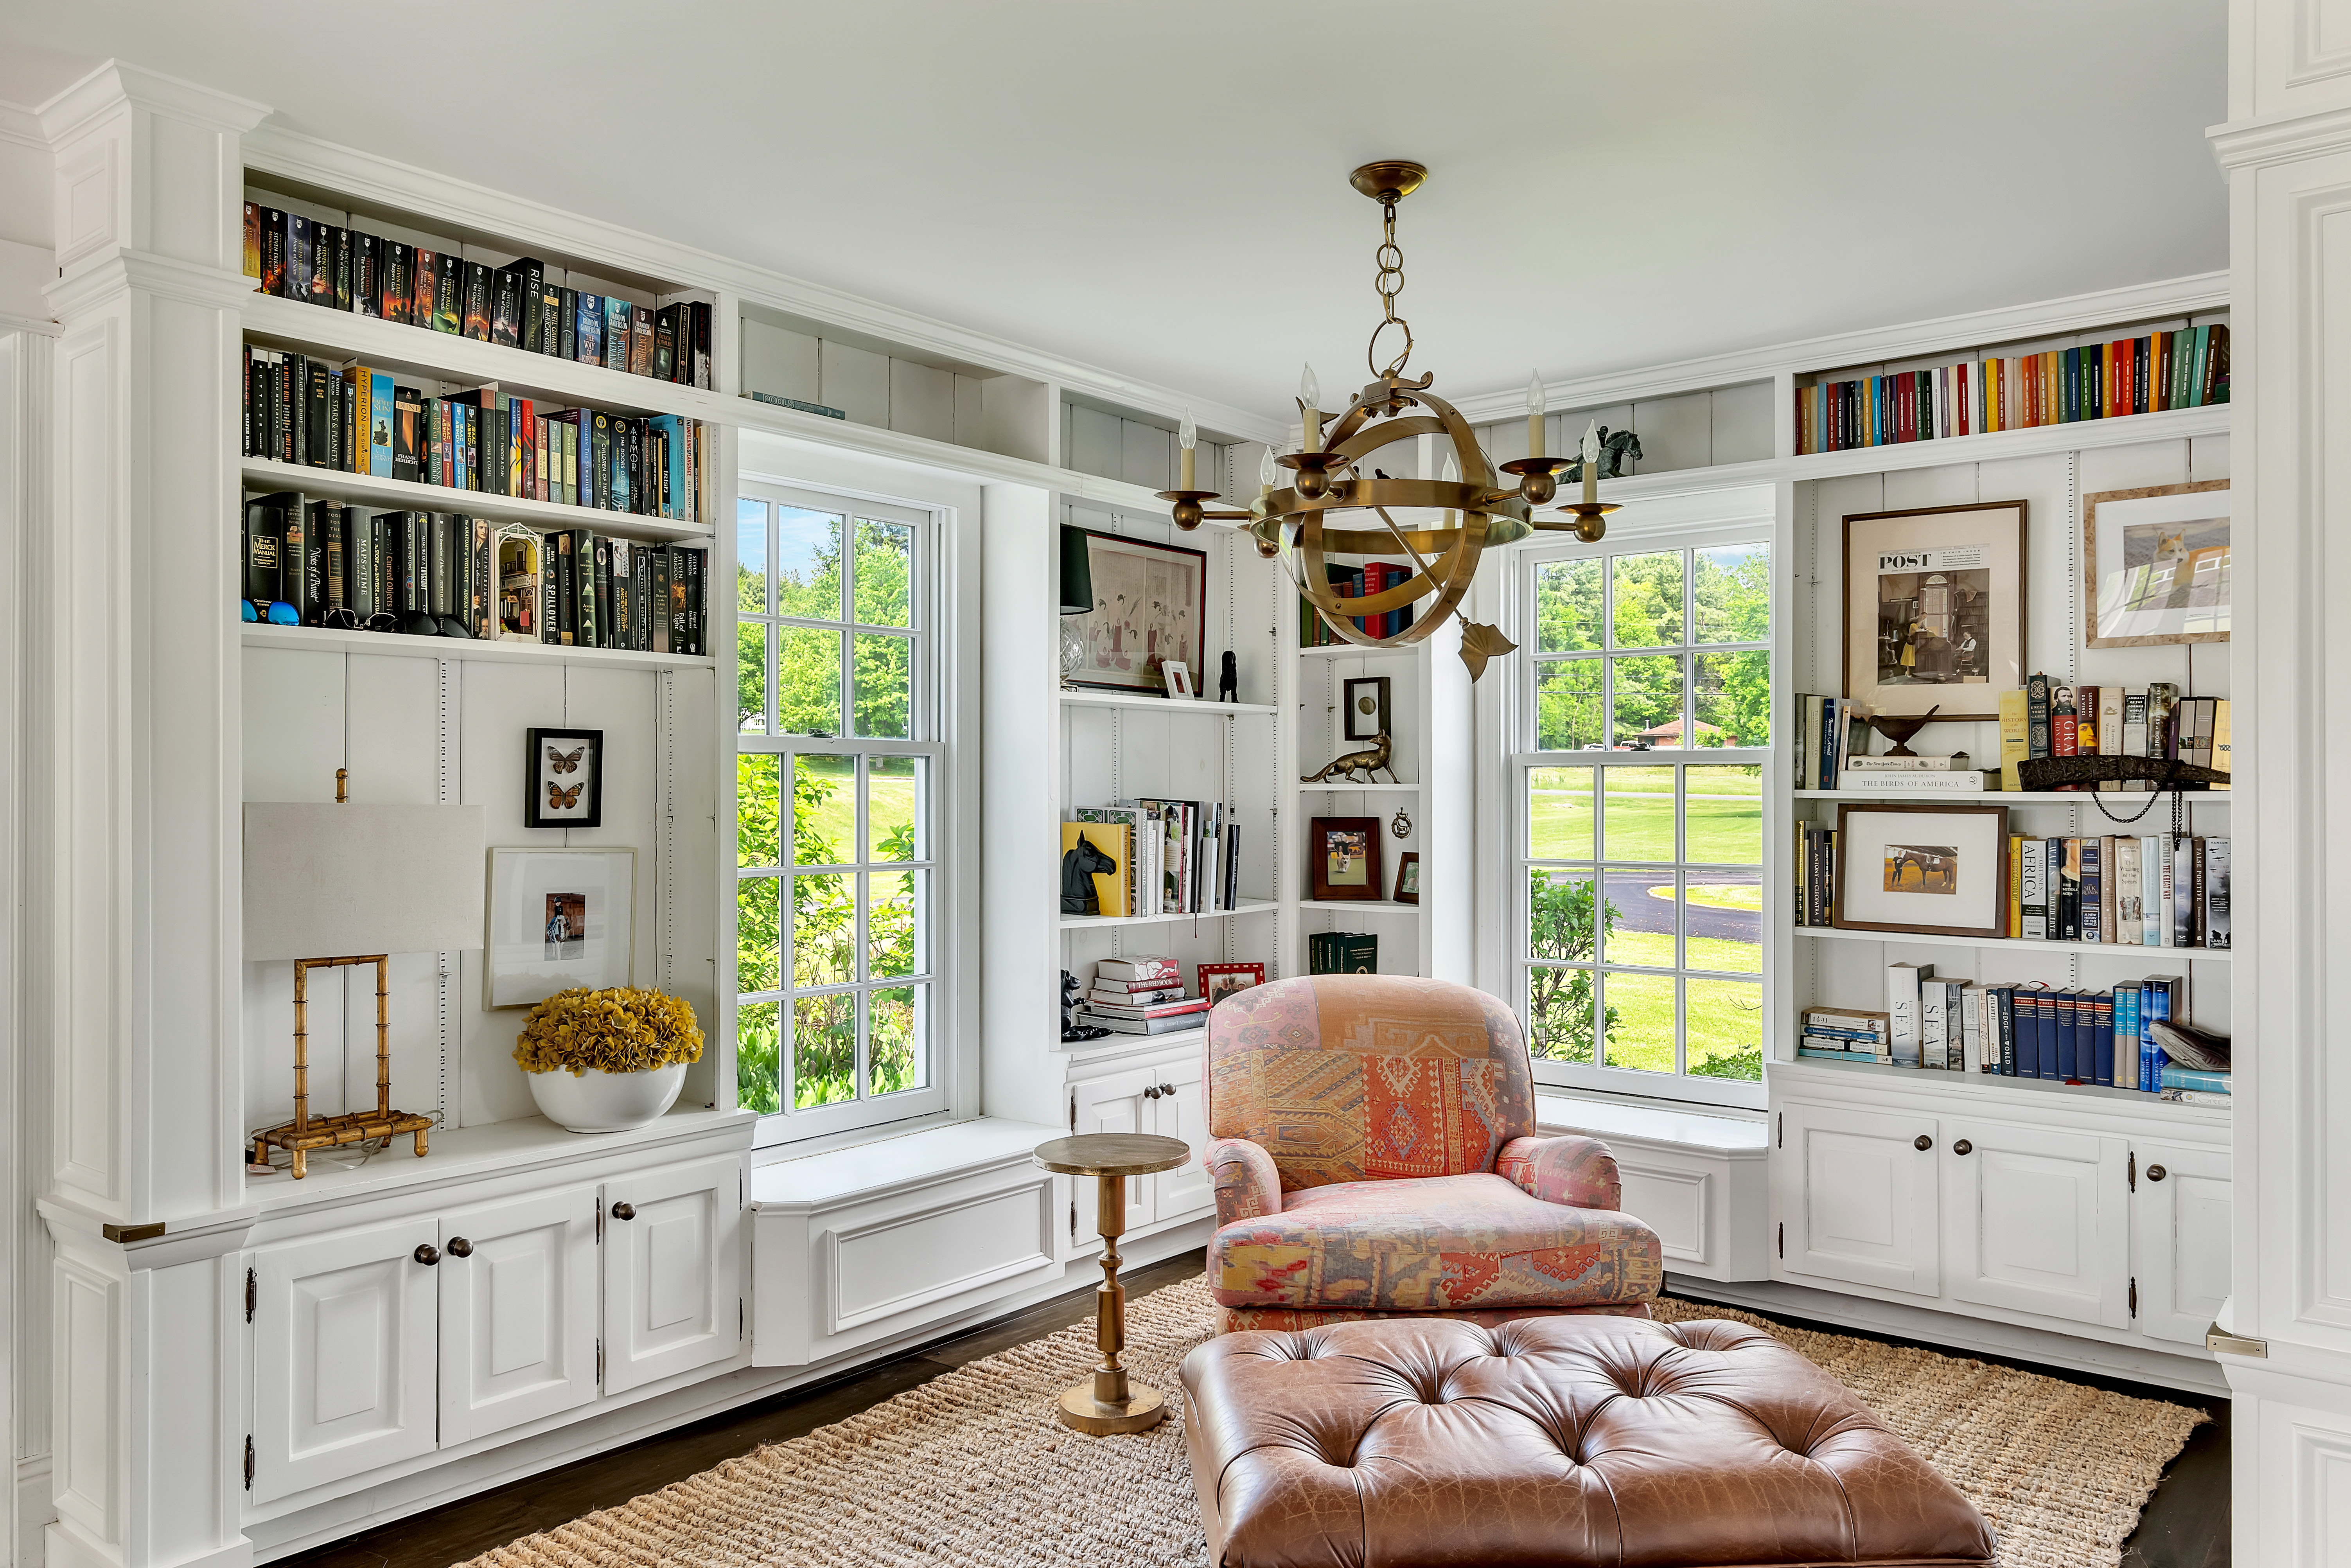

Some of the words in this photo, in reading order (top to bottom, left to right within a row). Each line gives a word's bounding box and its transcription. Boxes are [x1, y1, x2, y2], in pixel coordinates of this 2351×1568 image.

[530, 269, 539, 299] RISE
[583, 317, 598, 327] BRANDON
[611, 312, 625, 322] BRANDON
[581, 324, 600, 335] SANDERSON
[609, 320, 627, 329] SANDERSON
[584, 340, 595, 350] WAY
[582, 355, 596, 365] KINGS
[618, 362, 625, 370] OF
[763, 394, 794, 408] POOLS
[397, 403, 420, 412] DUNE
[602, 473, 606, 481] OF
[254, 542, 275, 550] MERCK
[310, 548, 321, 565] Notes
[1879, 554, 1931, 569] POST
[311, 577, 320, 602] Pianist
[385, 582, 394, 607] Objects
[2024, 845, 2036, 898] AFRICA
[1895, 1002, 1908, 1038] SEA
[1925, 1005, 1939, 1045] SEA
